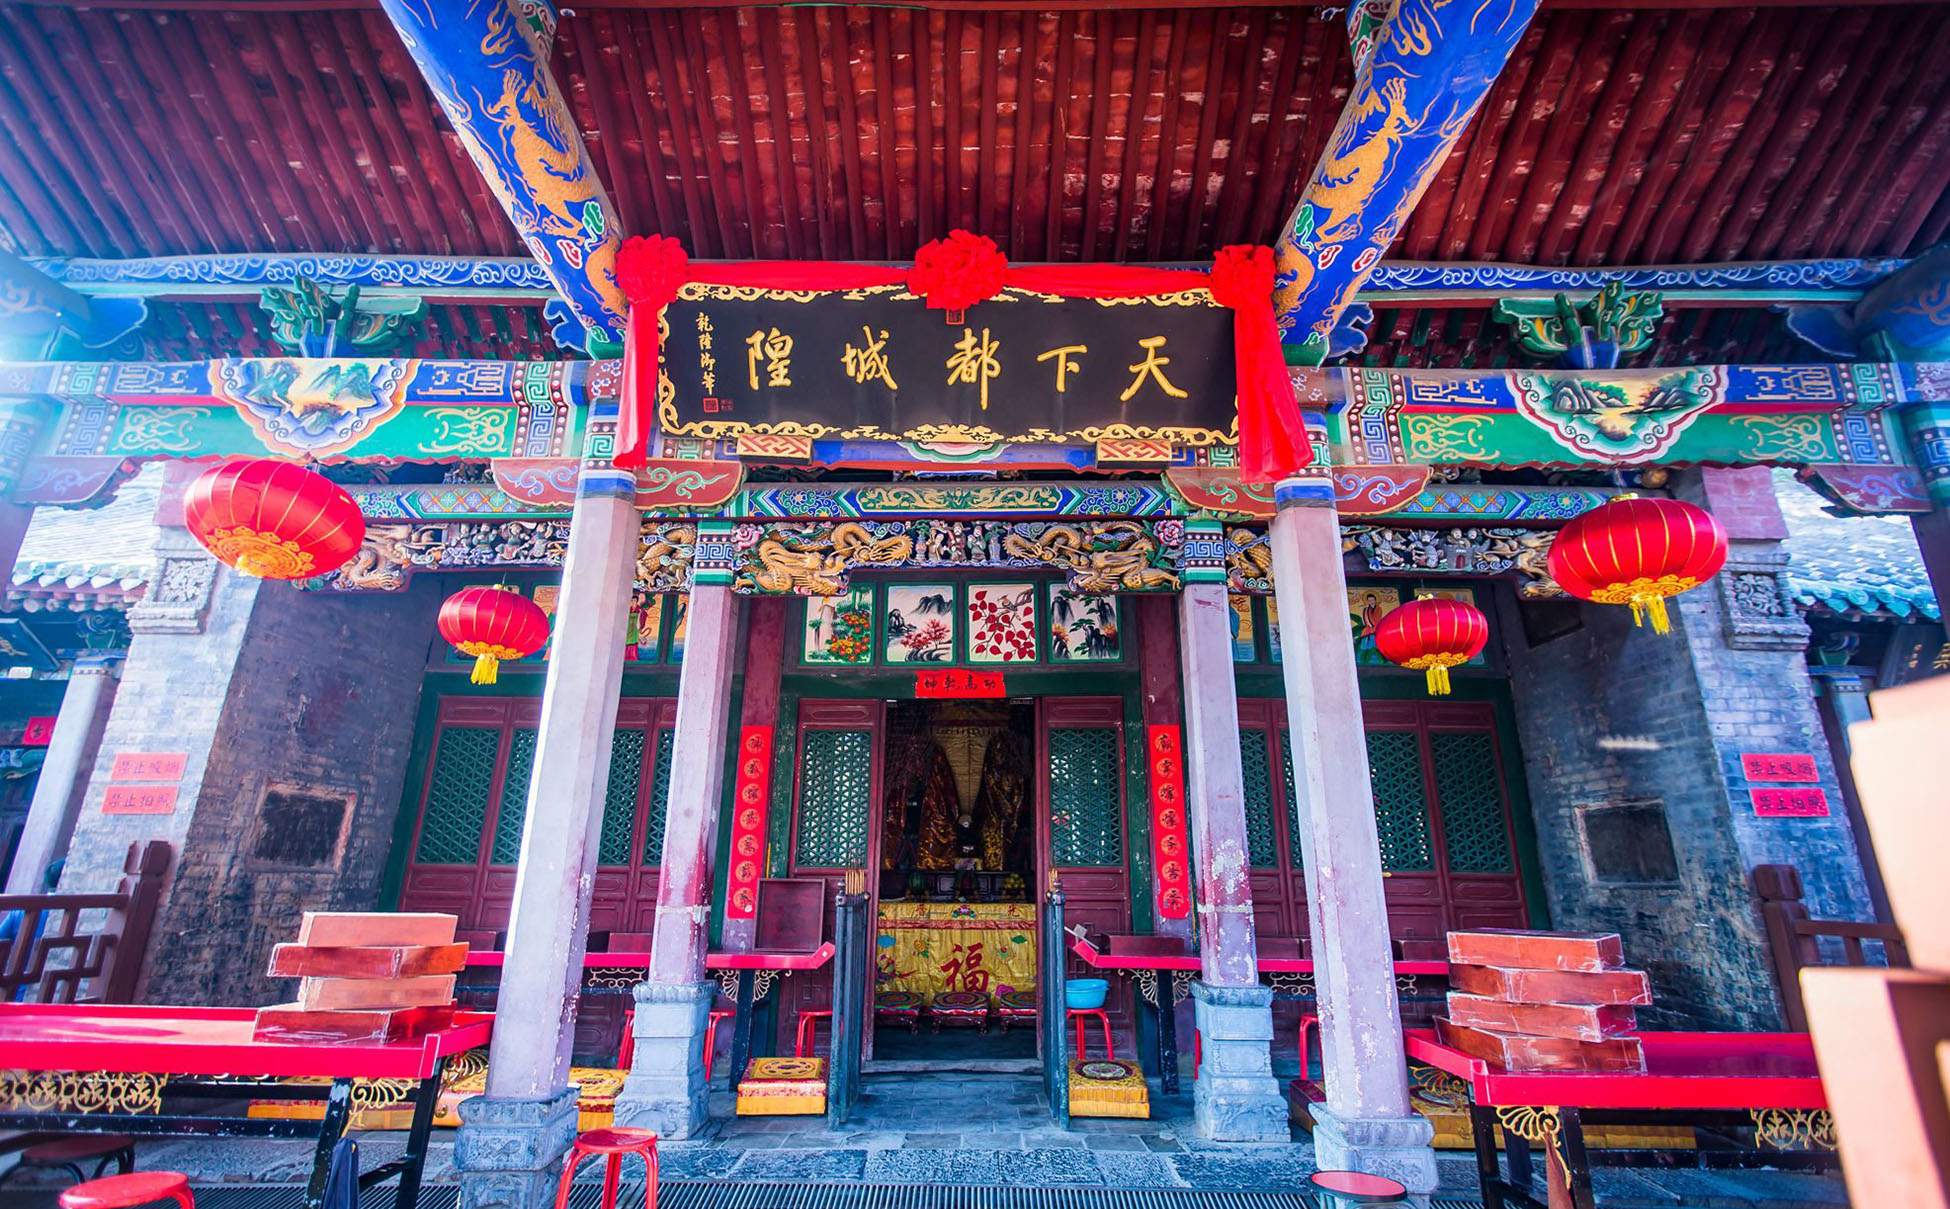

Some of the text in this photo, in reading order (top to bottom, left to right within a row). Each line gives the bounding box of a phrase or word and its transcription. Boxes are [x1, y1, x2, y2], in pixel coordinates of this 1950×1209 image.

[745, 325, 1188, 410] 天下都城隍
[940, 941, 990, 993] 福
